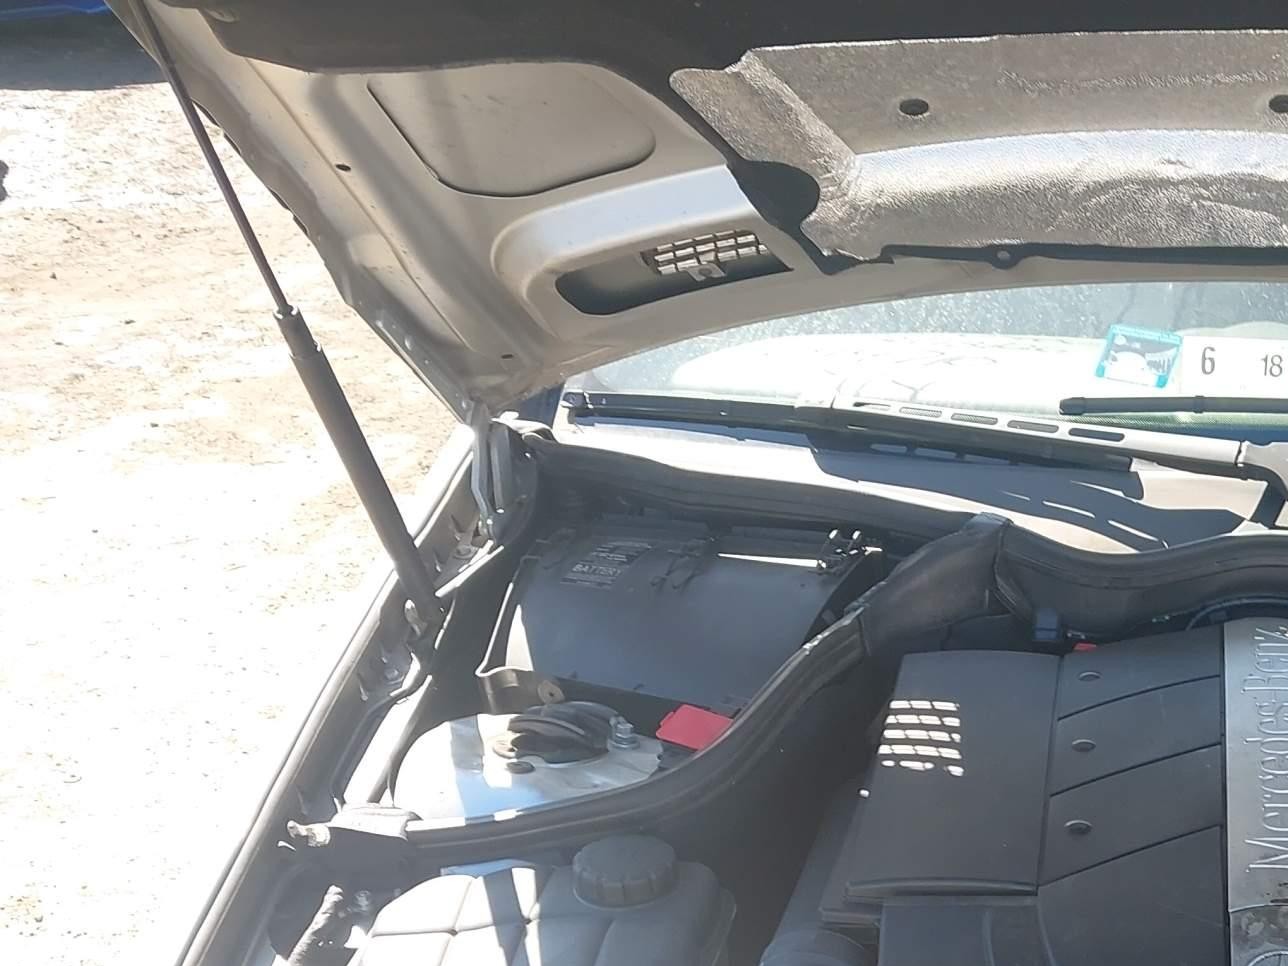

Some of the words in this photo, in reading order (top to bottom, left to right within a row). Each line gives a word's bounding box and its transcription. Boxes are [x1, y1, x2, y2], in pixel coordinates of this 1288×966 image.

[1201, 346, 1215, 375] 6
[1261, 354, 1283, 377] 18
[572, 564, 621, 576] BATTERY
